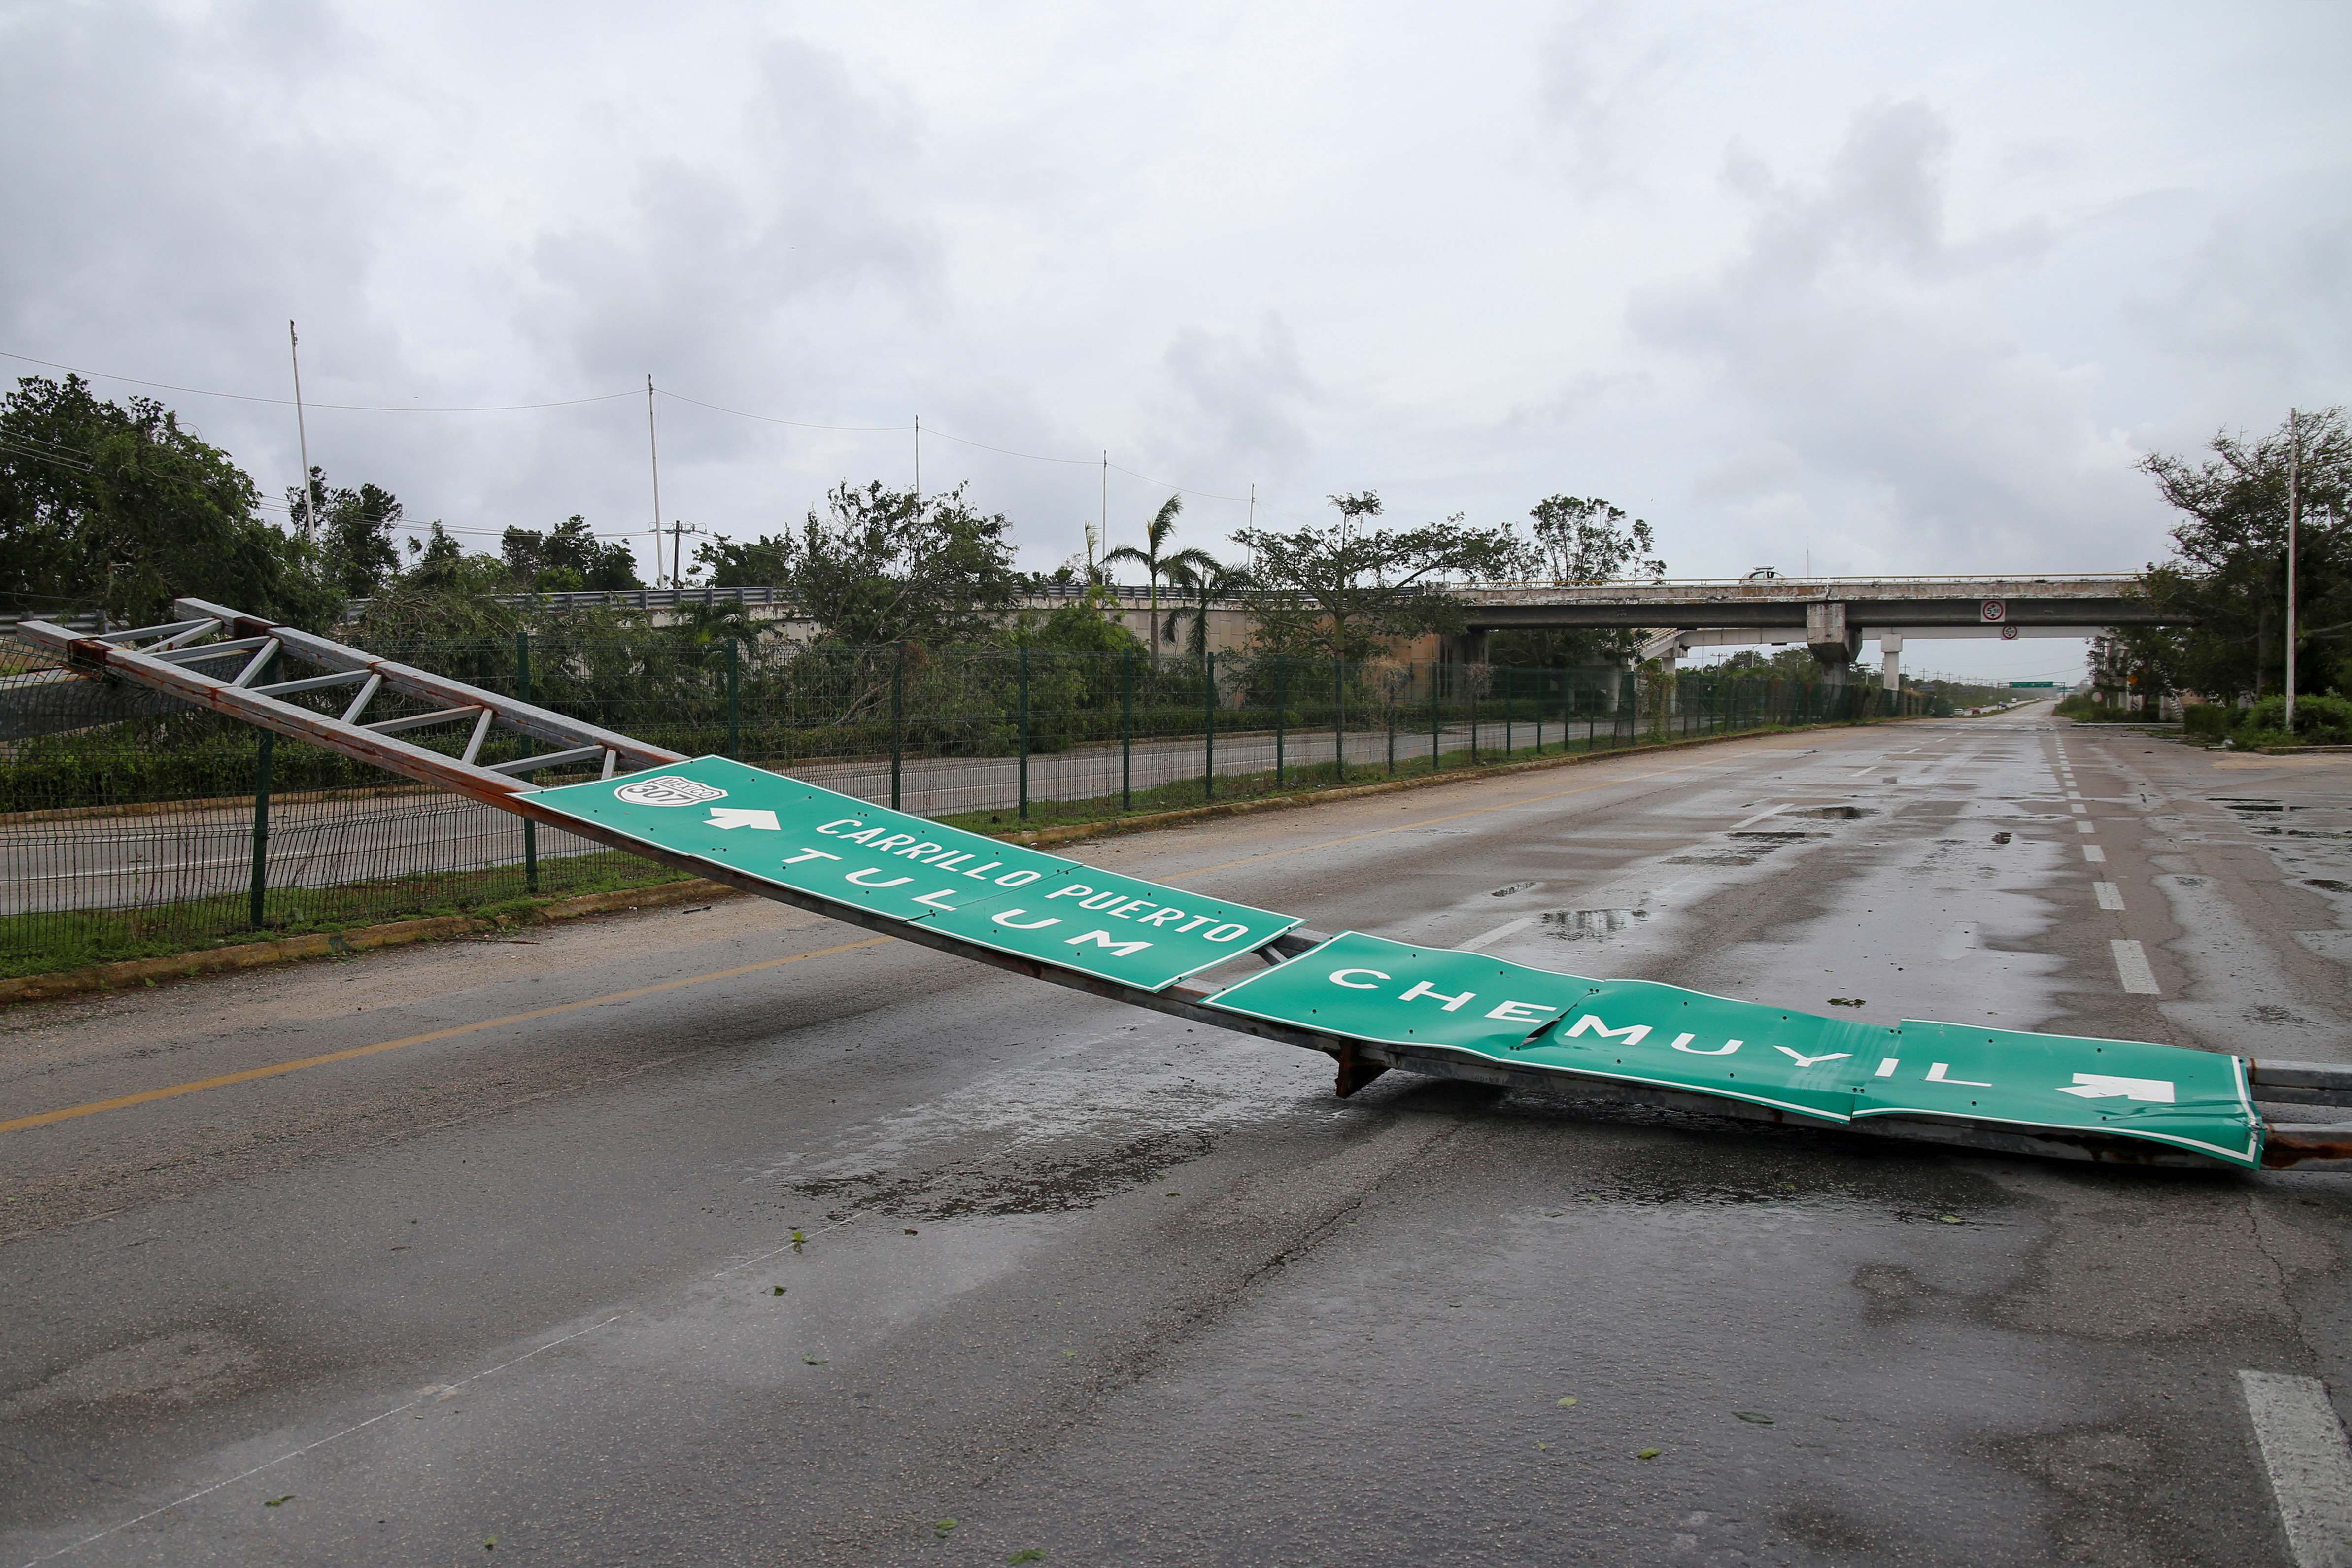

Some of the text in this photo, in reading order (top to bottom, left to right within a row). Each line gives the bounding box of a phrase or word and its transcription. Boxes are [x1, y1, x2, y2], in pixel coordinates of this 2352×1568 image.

[627, 785, 693, 802] 307
[659, 779, 715, 797] MEXICO
[782, 847, 1154, 957] TULUM
[816, 819, 1249, 942] CARRILLO PUERTO
[1329, 968, 1993, 1087] CHEMUYIL
